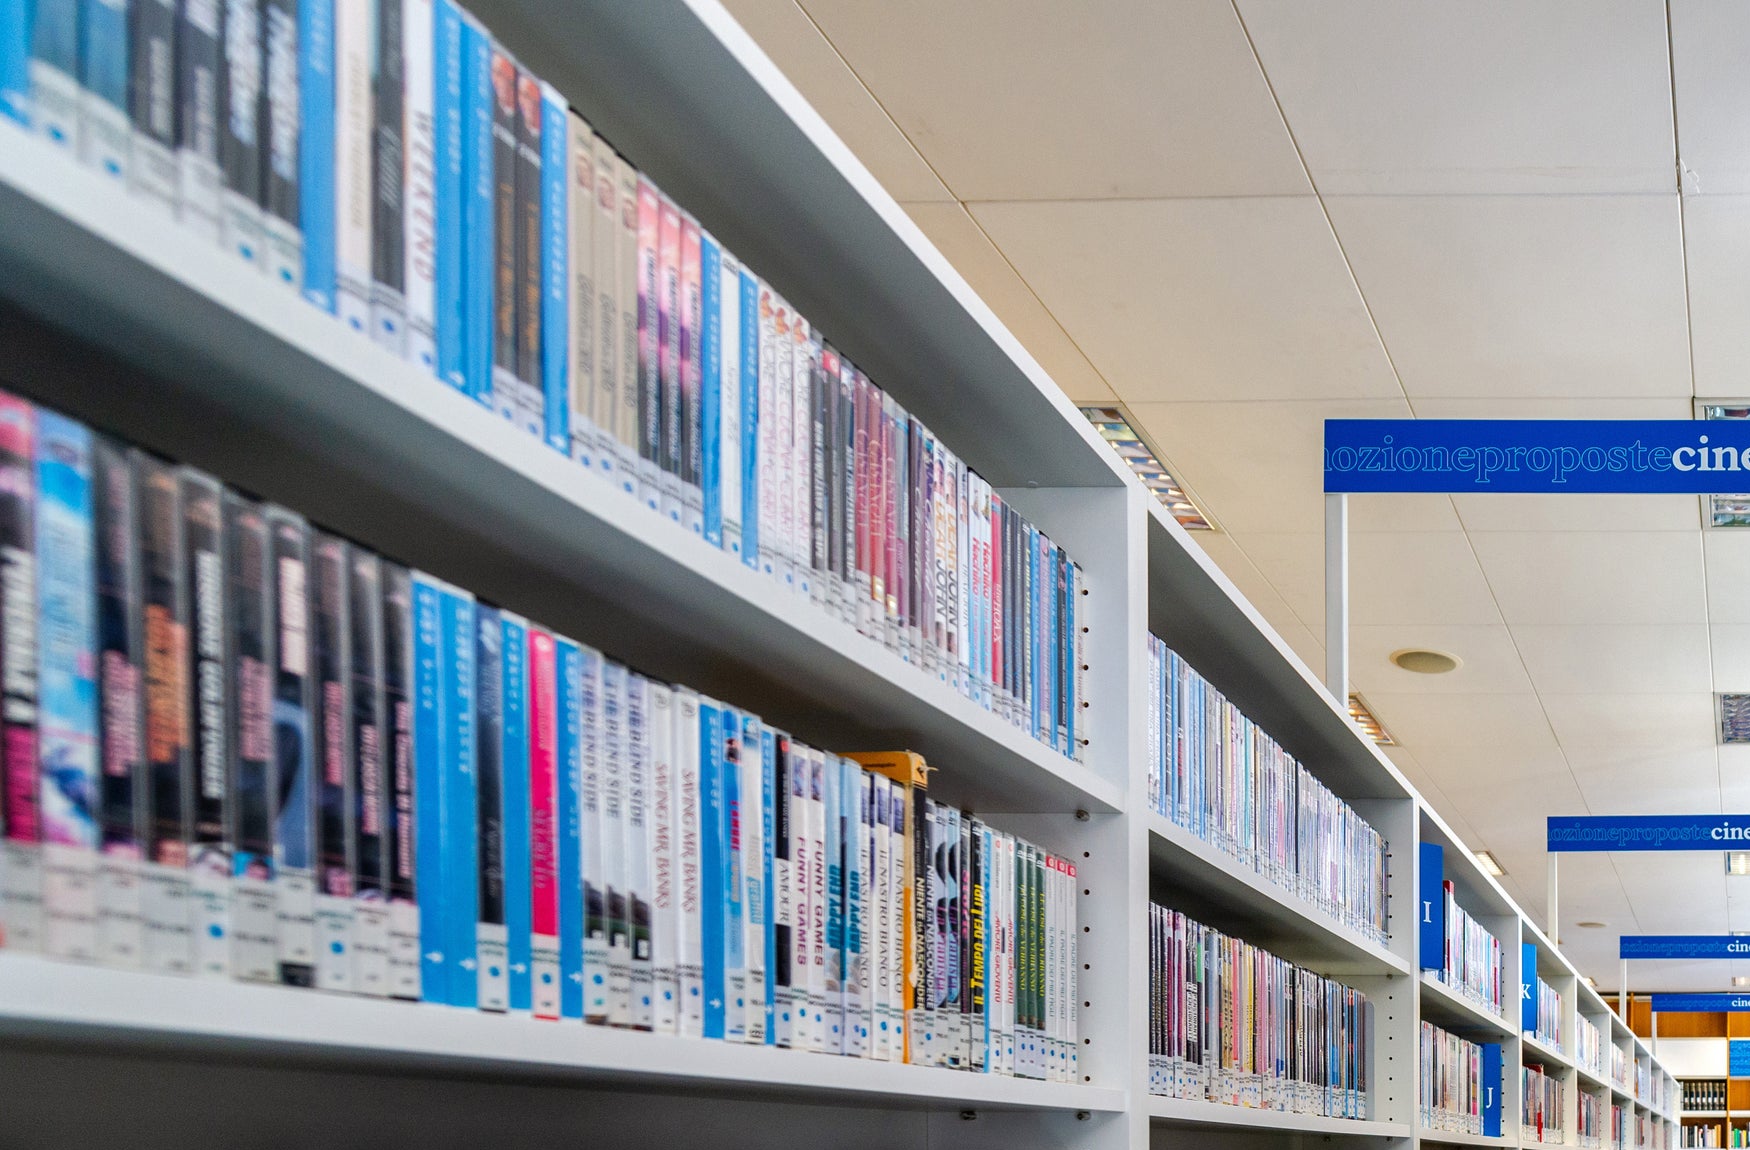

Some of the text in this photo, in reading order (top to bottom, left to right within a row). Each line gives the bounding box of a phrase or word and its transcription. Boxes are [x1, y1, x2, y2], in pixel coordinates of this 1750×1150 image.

[936, 500, 946, 616] DEAR JOHN
[993, 601, 1001, 643] HOAX
[583, 673, 596, 813] THE BLIND SIDE
[779, 863, 788, 923] AMOUR
[797, 837, 806, 966] FUNNY GAMES
[828, 864, 840, 949] HAPPY END
[879, 849, 888, 988] IL NASTRO BIANCO
[926, 865, 935, 909] NIENTE
[970, 884, 984, 1005] IL TEMPO DEI LUPI
[1485, 1087, 1493, 1108] J
